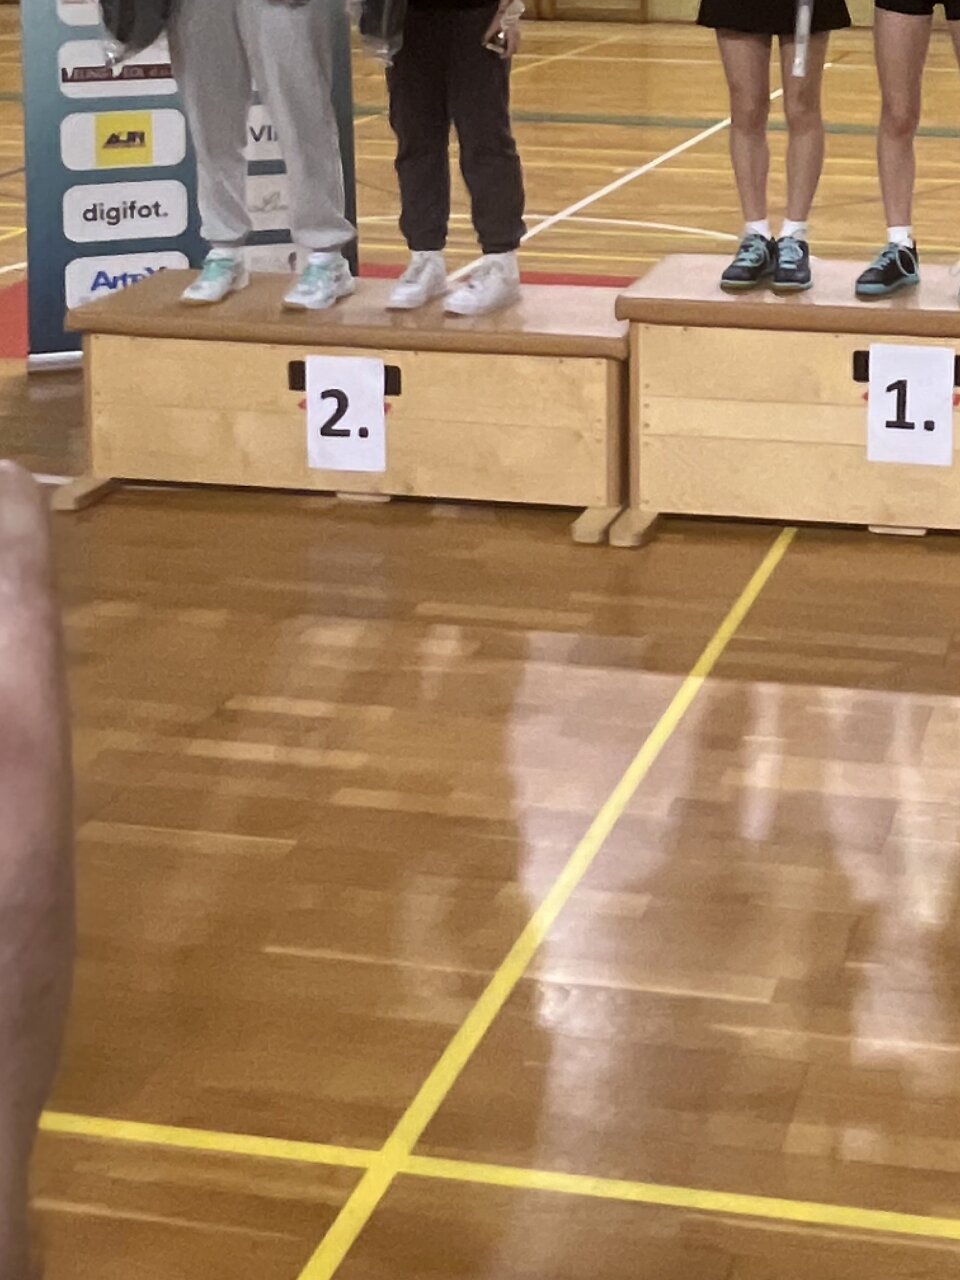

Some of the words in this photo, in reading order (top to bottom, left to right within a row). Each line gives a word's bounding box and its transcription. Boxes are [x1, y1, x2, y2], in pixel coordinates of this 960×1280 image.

[250, 125, 278, 142] VI
[83, 200, 168, 226] digifot.
[320, 388, 369, 438] 2.
[885, 379, 935, 431] 1.
